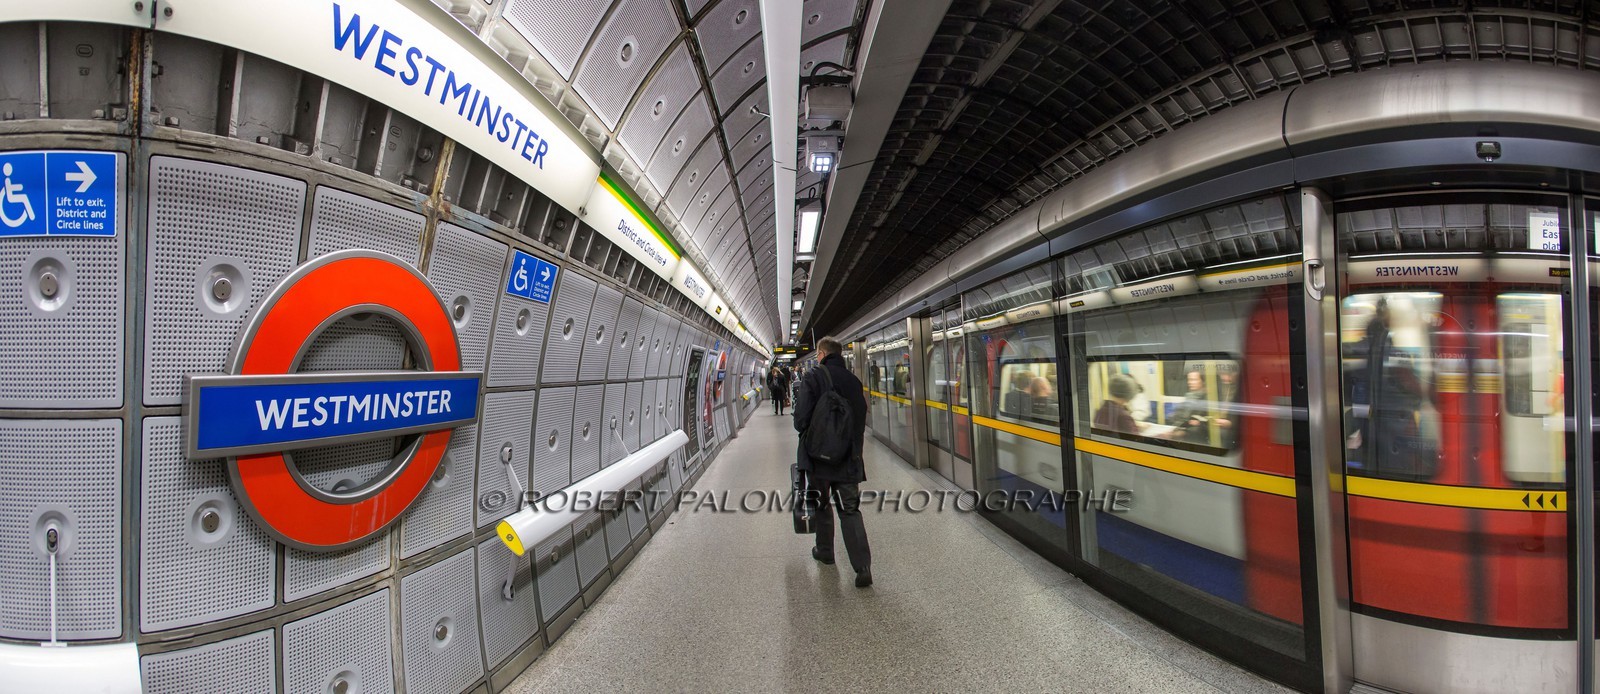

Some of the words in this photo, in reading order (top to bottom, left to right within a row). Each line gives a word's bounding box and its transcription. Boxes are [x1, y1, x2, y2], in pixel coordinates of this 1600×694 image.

[332, 2, 549, 170] WESTMINSTER
[56, 196, 72, 207] Lift
[74, 198, 84, 207] to
[86, 198, 106, 208] exit,
[56, 209, 88, 218] District
[90, 210, 106, 218] and
[56, 220, 81, 230] Circle
[83, 220, 104, 230] lines
[617, 218, 638, 242] District
[636, 237, 646, 248] and
[644, 242, 656, 258] Circle
[255, 389, 452, 431] WESTMINSTER
